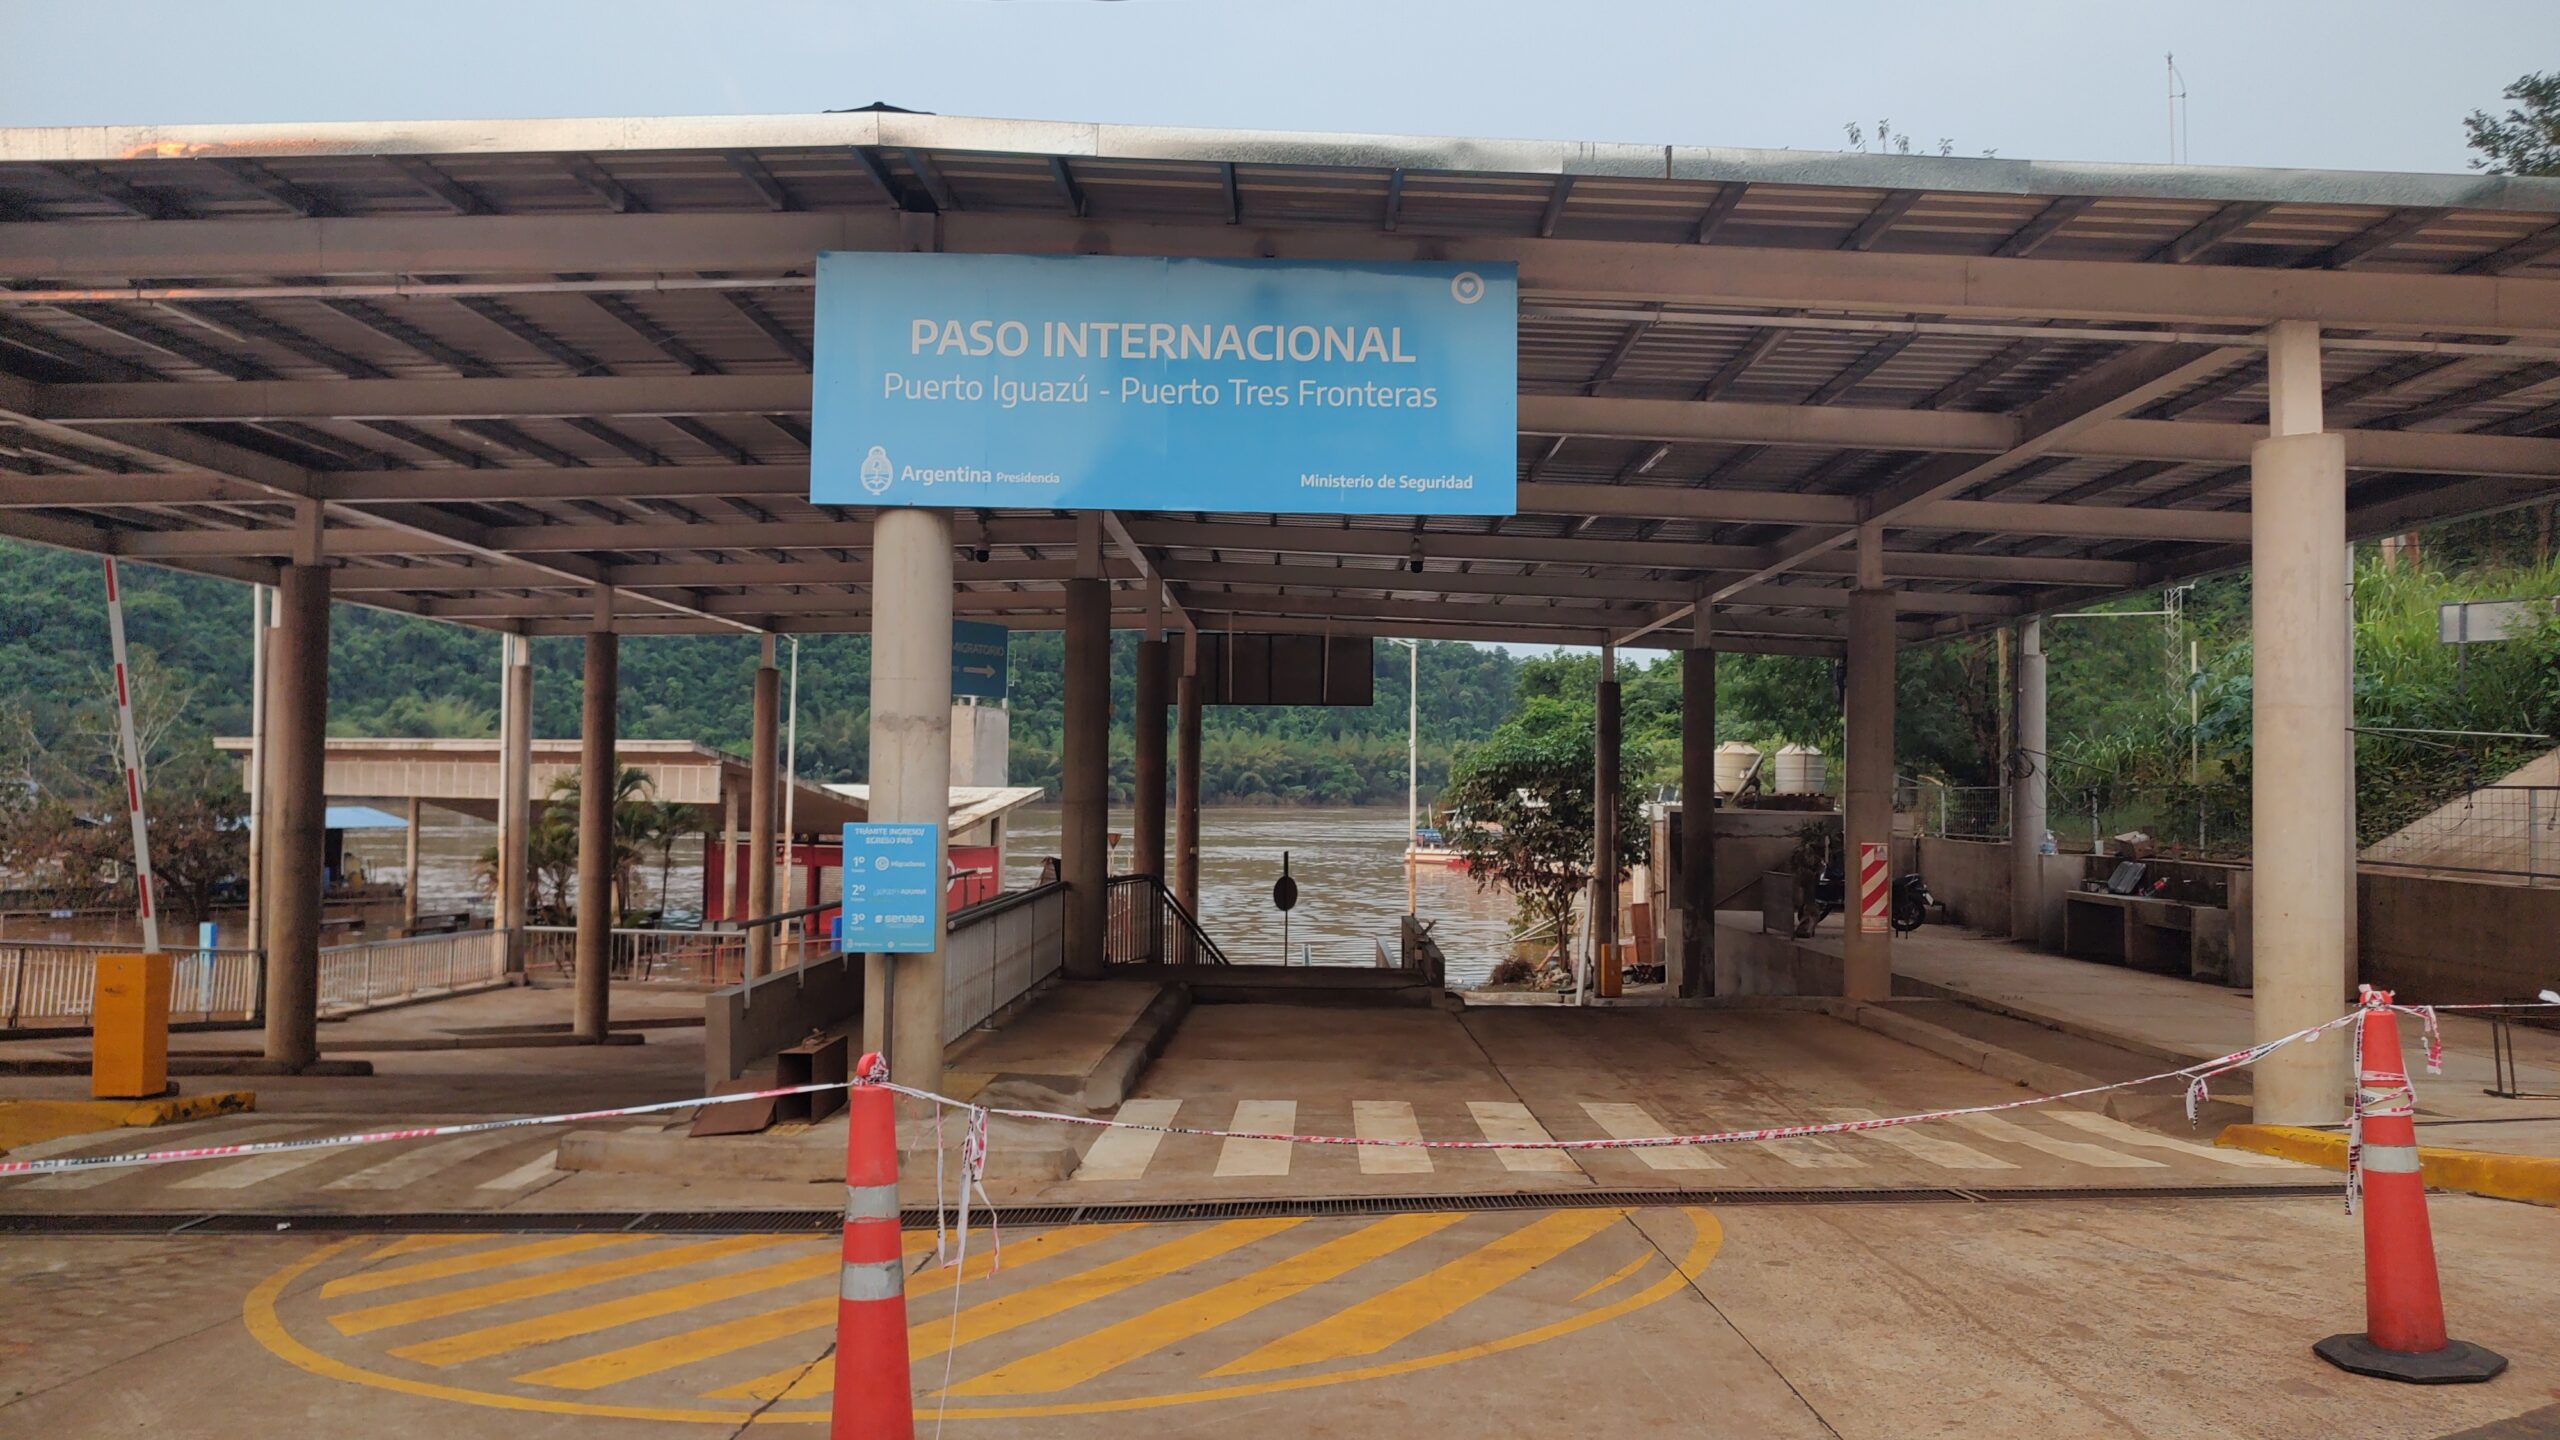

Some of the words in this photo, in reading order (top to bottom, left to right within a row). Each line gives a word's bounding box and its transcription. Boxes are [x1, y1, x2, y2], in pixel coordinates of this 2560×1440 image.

[911, 319, 1029, 358] PASO
[1044, 322, 1417, 363] INTERNACIONAL
[884, 372, 983, 401] Puerto
[993, 374, 1089, 409] Iguazú
[1121, 377, 1219, 405] Puerto
[1229, 379, 1289, 406] Tres
[1298, 379, 1438, 409] Fronteras
[901, 464, 992, 486] Argentina
[996, 471, 1061, 484] Presidencia
[1300, 473, 1375, 488] Ministerio
[1377, 474, 1395, 488] de
[1399, 474, 1473, 493] Seguridad
